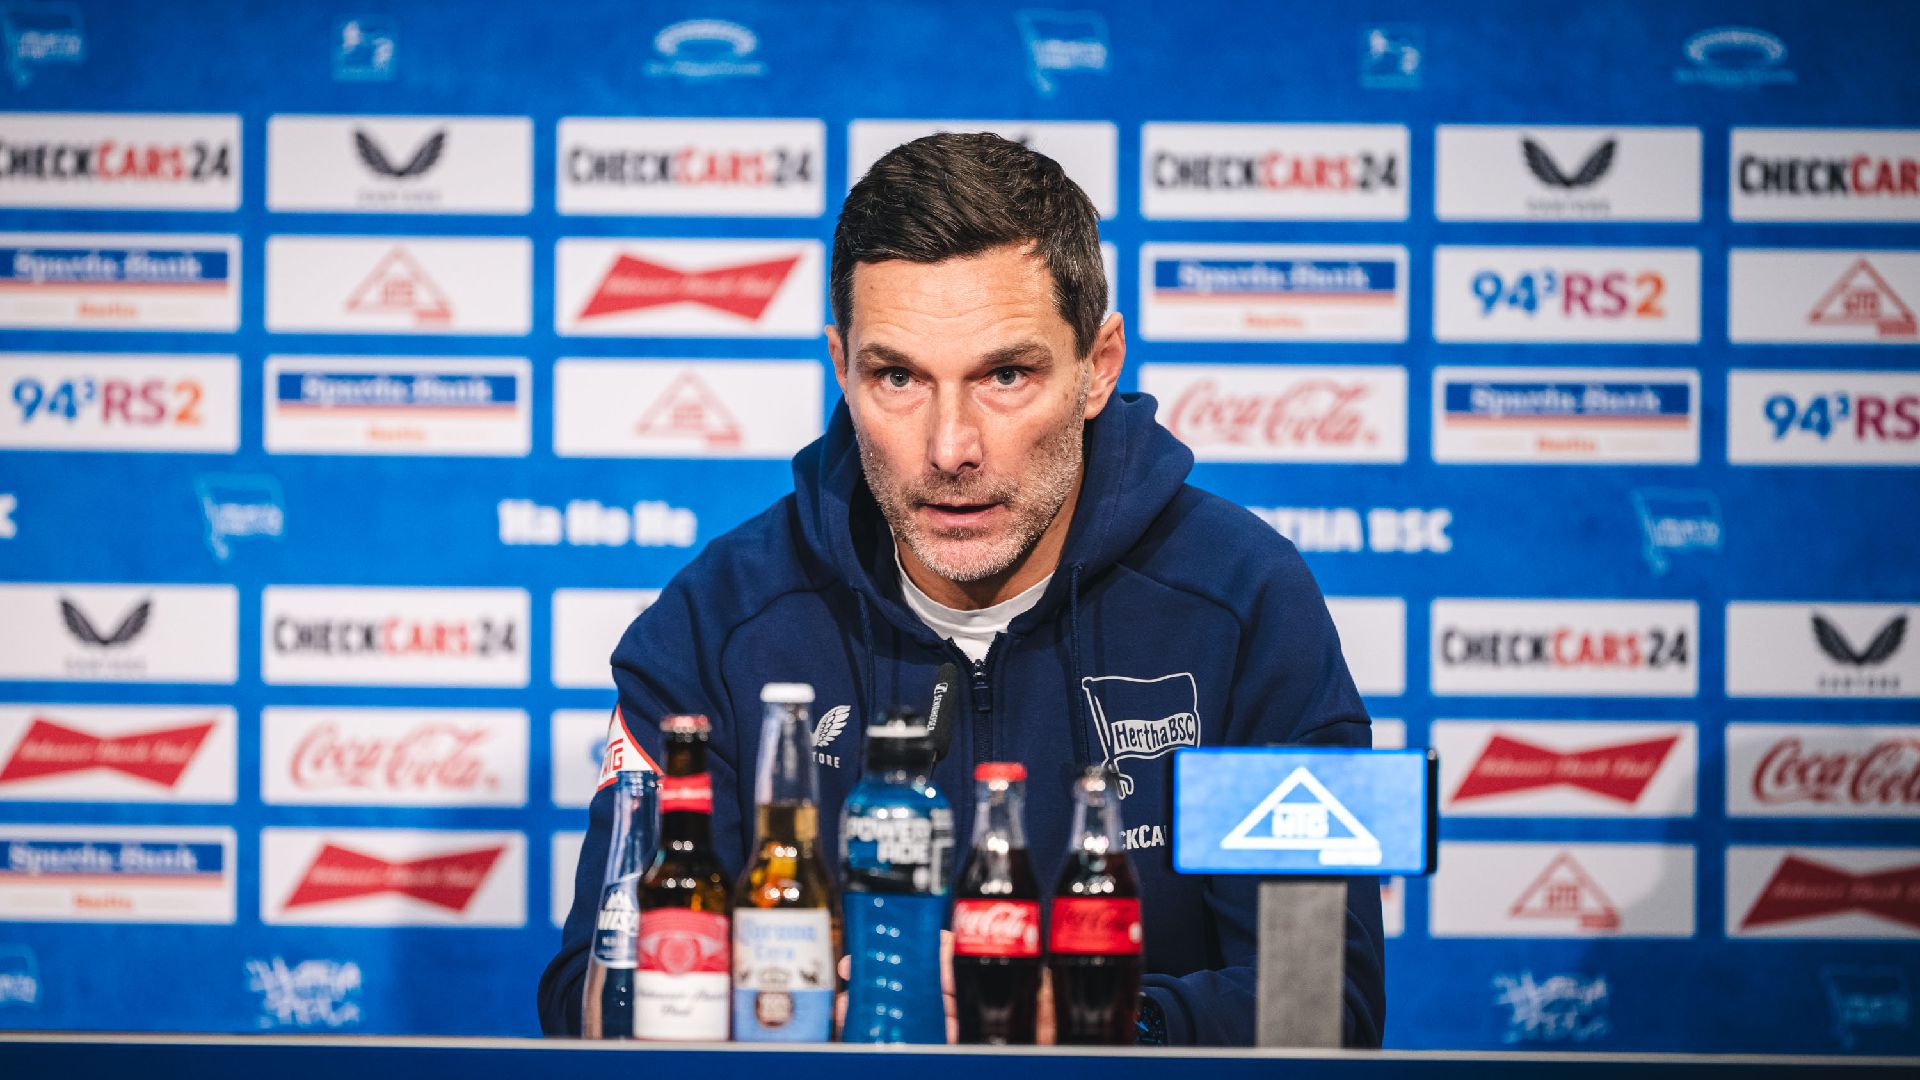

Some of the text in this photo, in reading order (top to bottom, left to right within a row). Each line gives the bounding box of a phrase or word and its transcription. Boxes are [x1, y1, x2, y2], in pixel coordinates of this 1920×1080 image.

[568, 147, 811, 187] CHECKCARS24
[1153, 152, 1398, 191] CHECKCARS24
[1368, 508, 1453, 553] BSC
[274, 618, 517, 657] CHECKCARS24
[1441, 628, 1688, 668] CHECKCARS24
[811, 751, 841, 769] TORE
